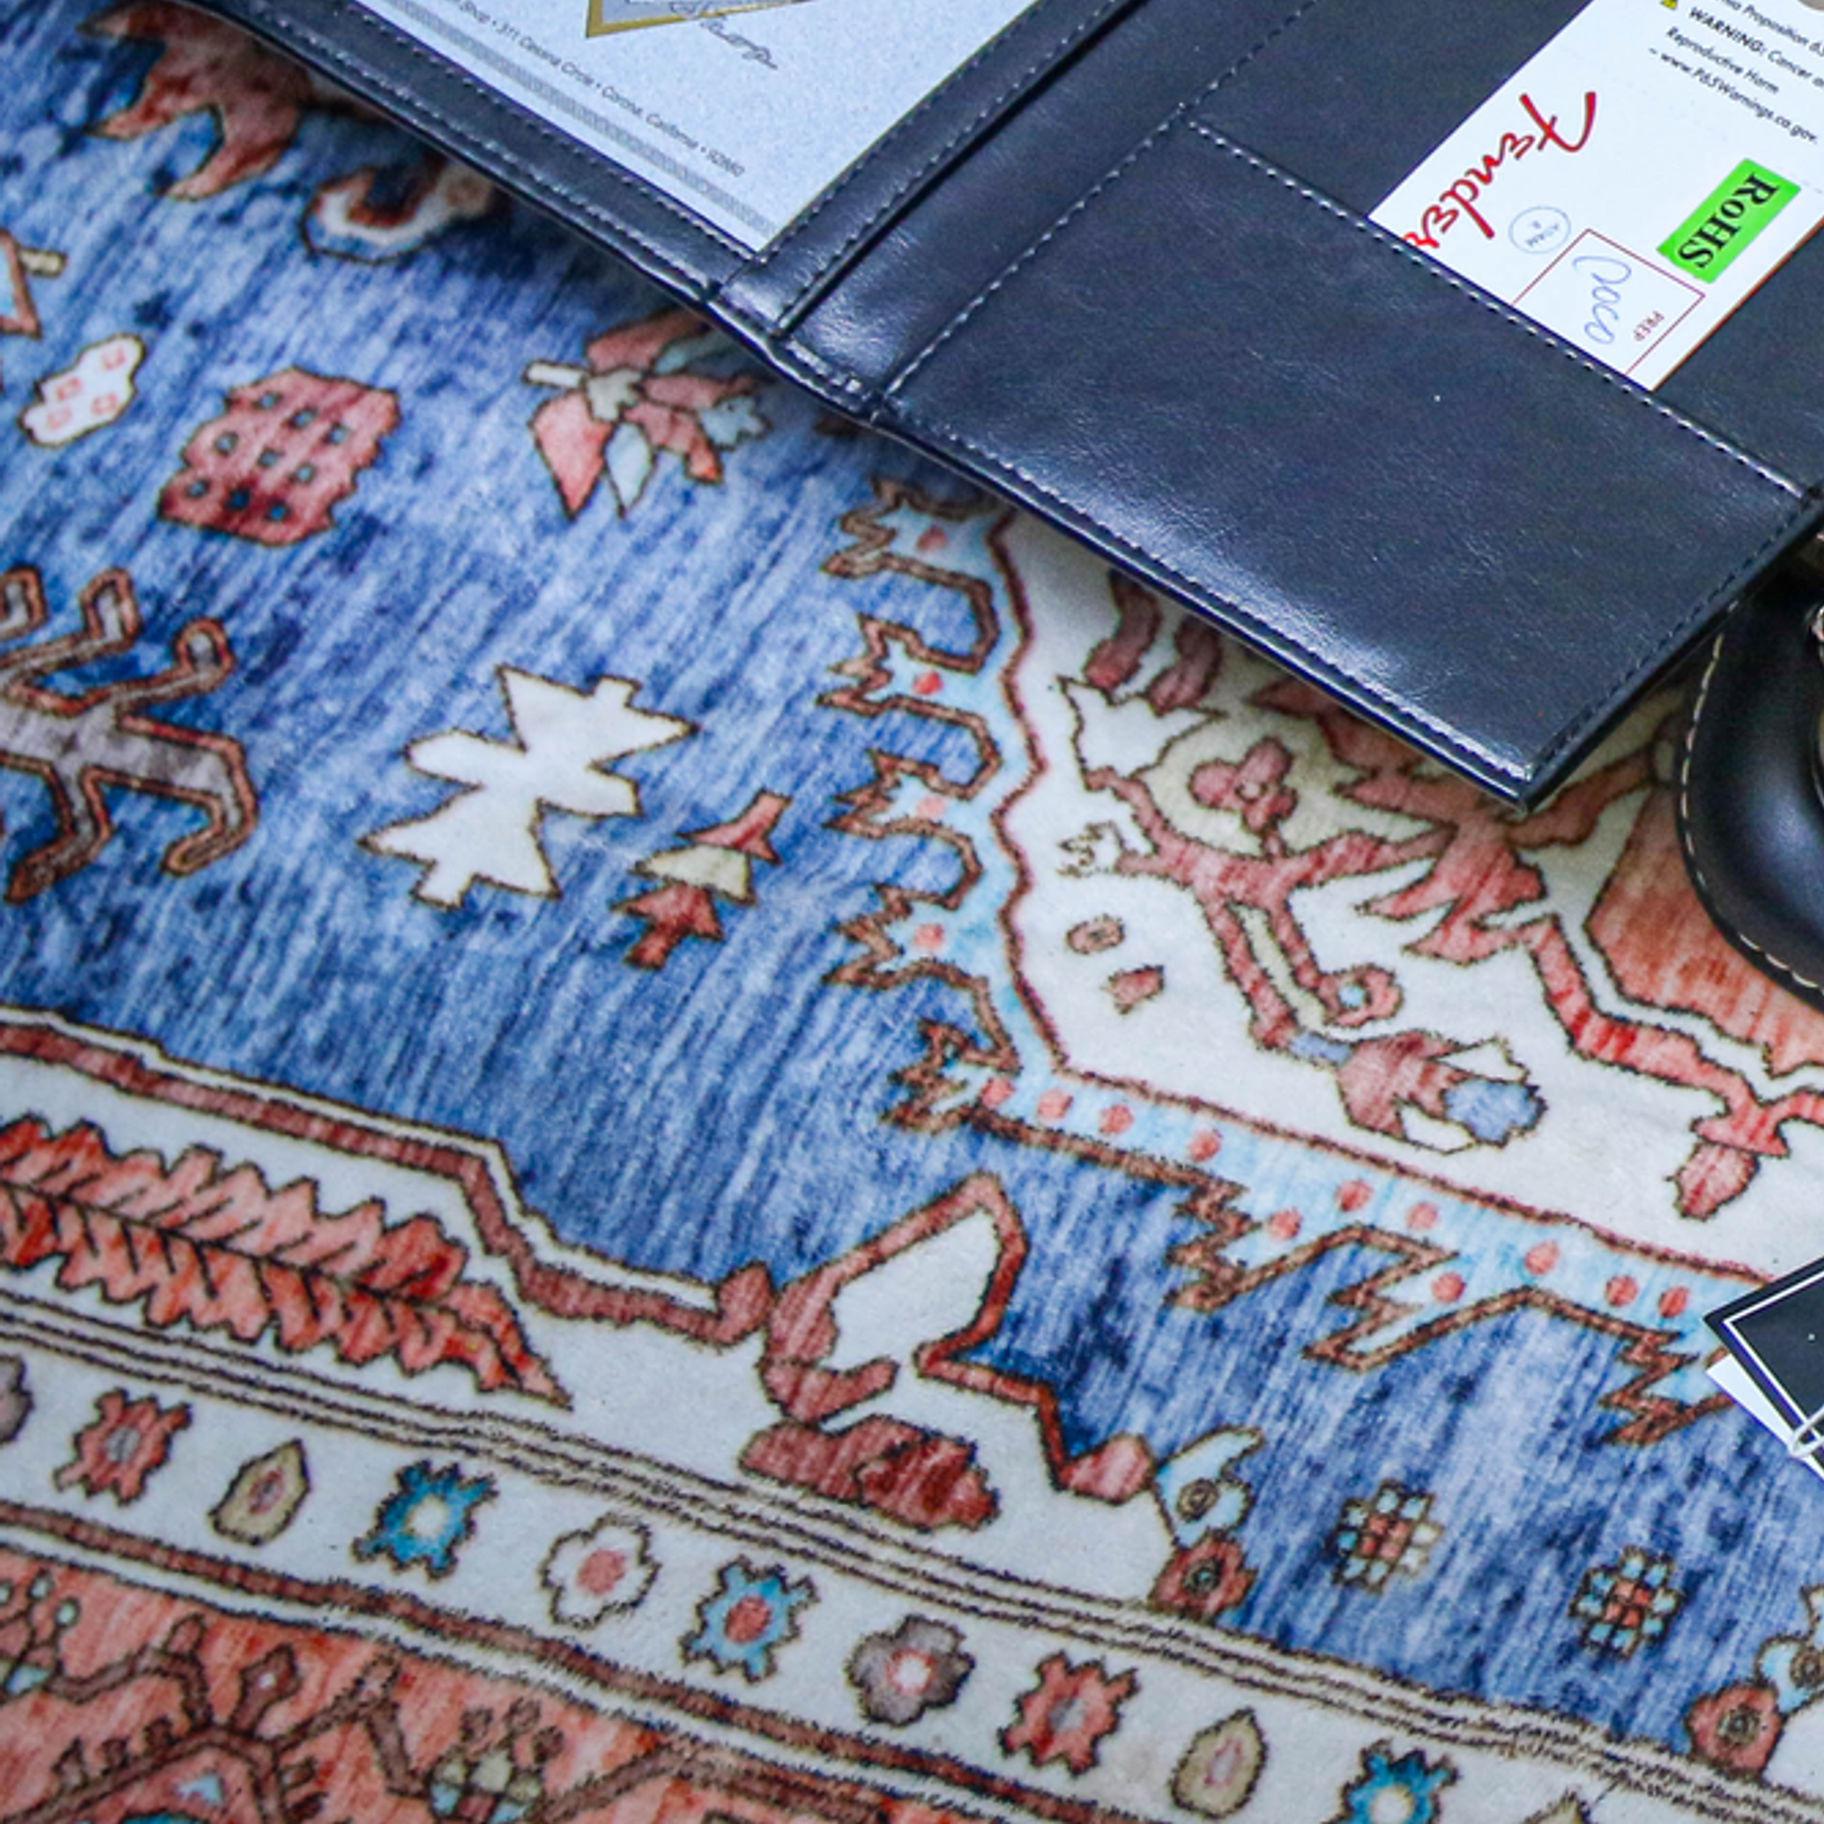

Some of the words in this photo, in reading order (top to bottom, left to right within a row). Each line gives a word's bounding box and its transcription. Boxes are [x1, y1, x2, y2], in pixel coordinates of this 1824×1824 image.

[1662, 25, 1747, 77] Reproductive
[1741, 68, 1782, 95] Harm
[1685, 5, 1770, 57] WARNING:
[1763, 48, 1815, 81] Cancer
[1737, 3, 1812, 49] Proposition
[1399, 90, 1597, 249] Fender
[1678, 172, 1782, 269] RoHS
[1633, 309, 1666, 343] PREP
